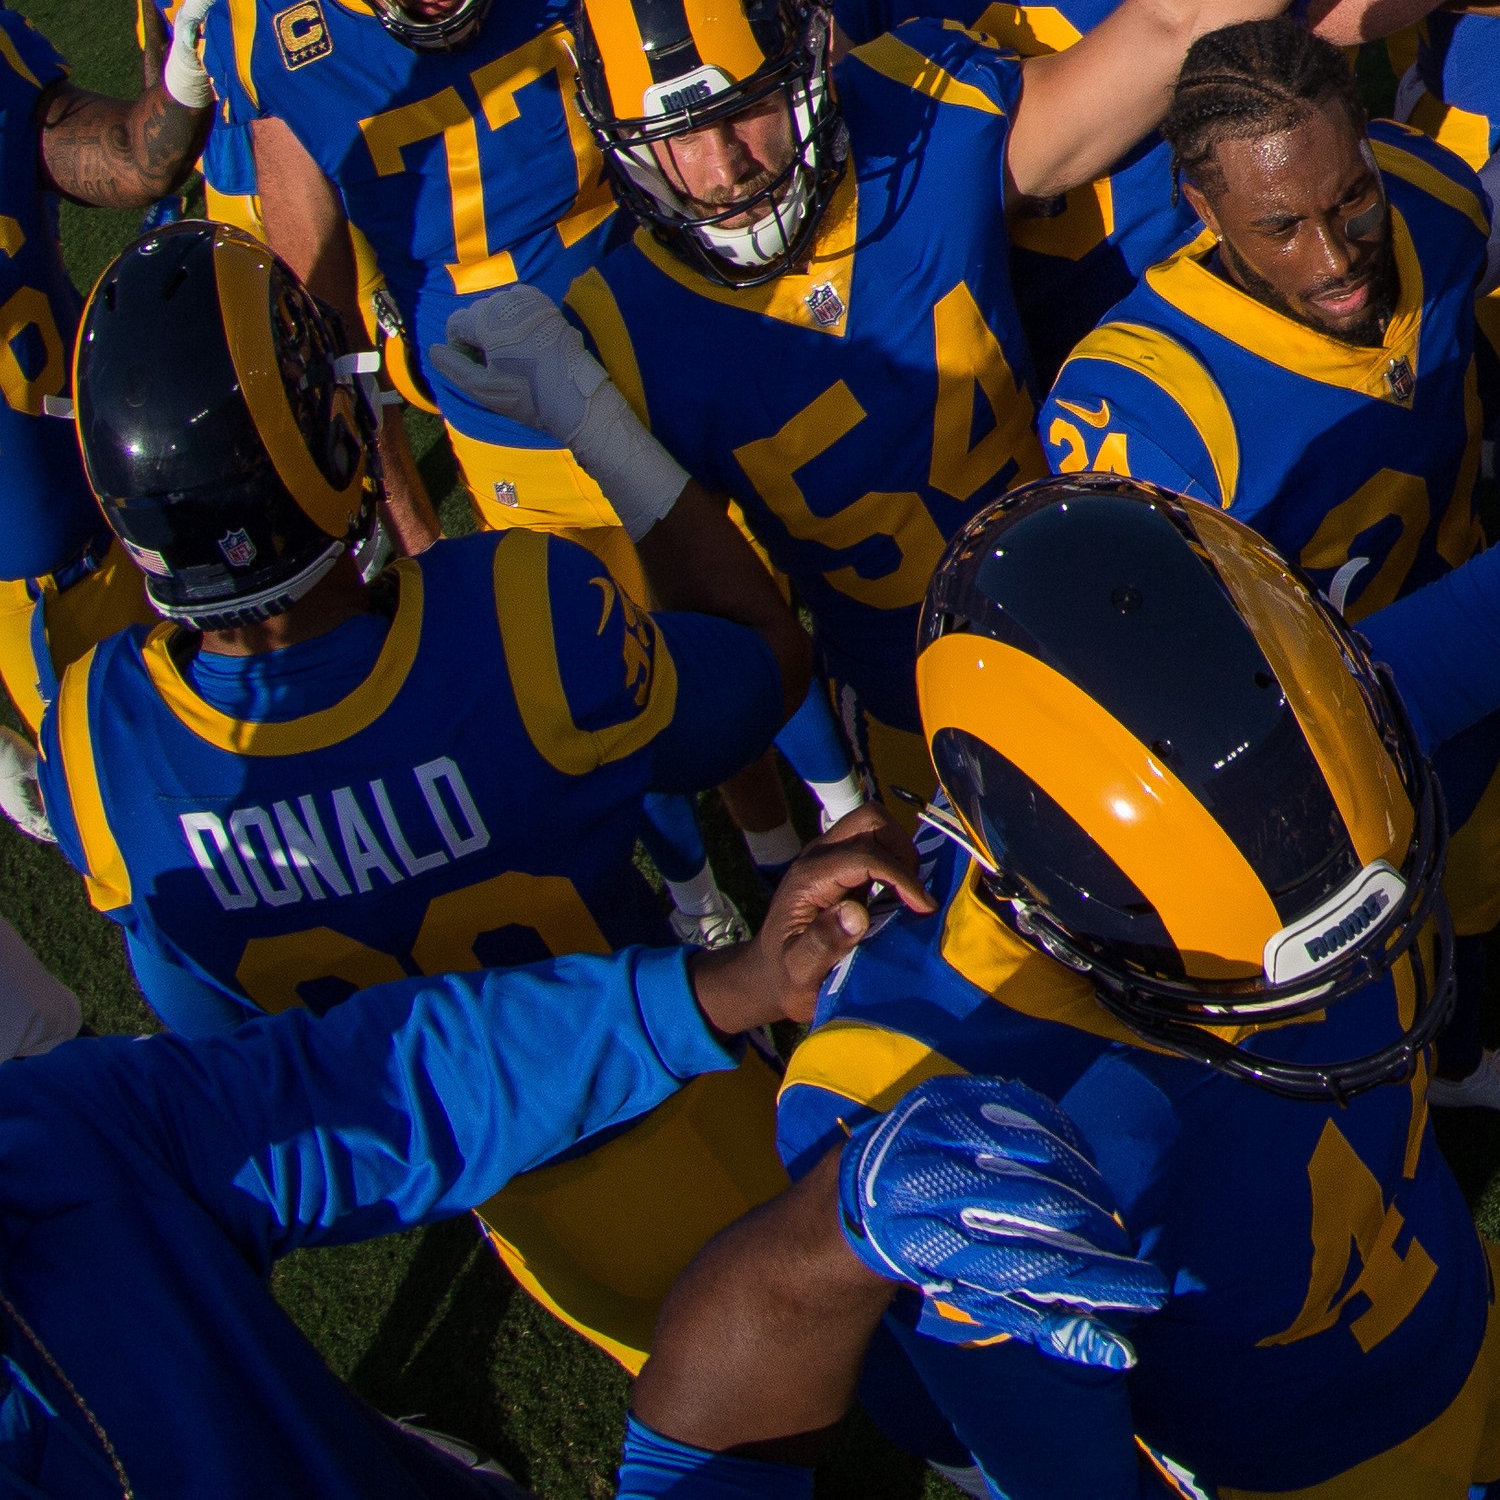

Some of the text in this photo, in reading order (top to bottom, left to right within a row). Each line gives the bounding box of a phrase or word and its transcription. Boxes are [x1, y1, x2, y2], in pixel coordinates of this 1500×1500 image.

[279, 4, 324, 50] C
[659, 79, 712, 111] RAMS
[358, 23, 622, 297] 77
[732, 280, 1050, 607] 54
[180, 756, 492, 912] DONALD
[1302, 888, 1393, 963] RAMS
